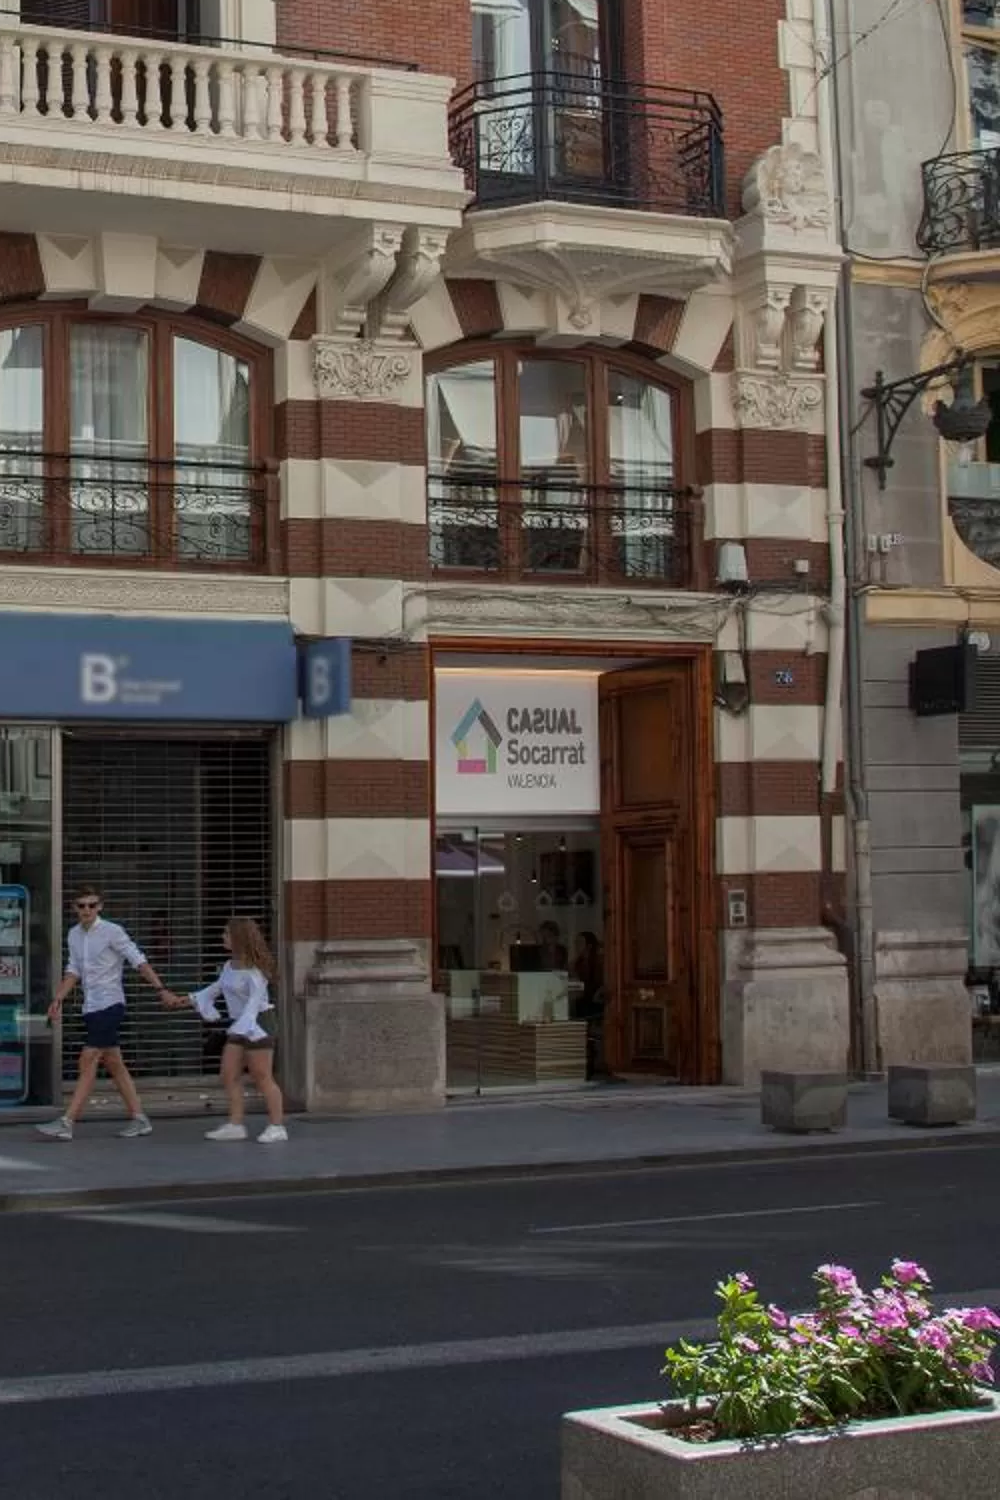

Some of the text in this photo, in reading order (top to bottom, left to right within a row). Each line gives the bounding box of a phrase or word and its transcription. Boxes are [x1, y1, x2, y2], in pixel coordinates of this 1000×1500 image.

[80, 652, 118, 704] B
[311, 657, 331, 705] B
[506, 707, 582, 734] CASUAL
[506, 739, 586, 765] Socarrat
